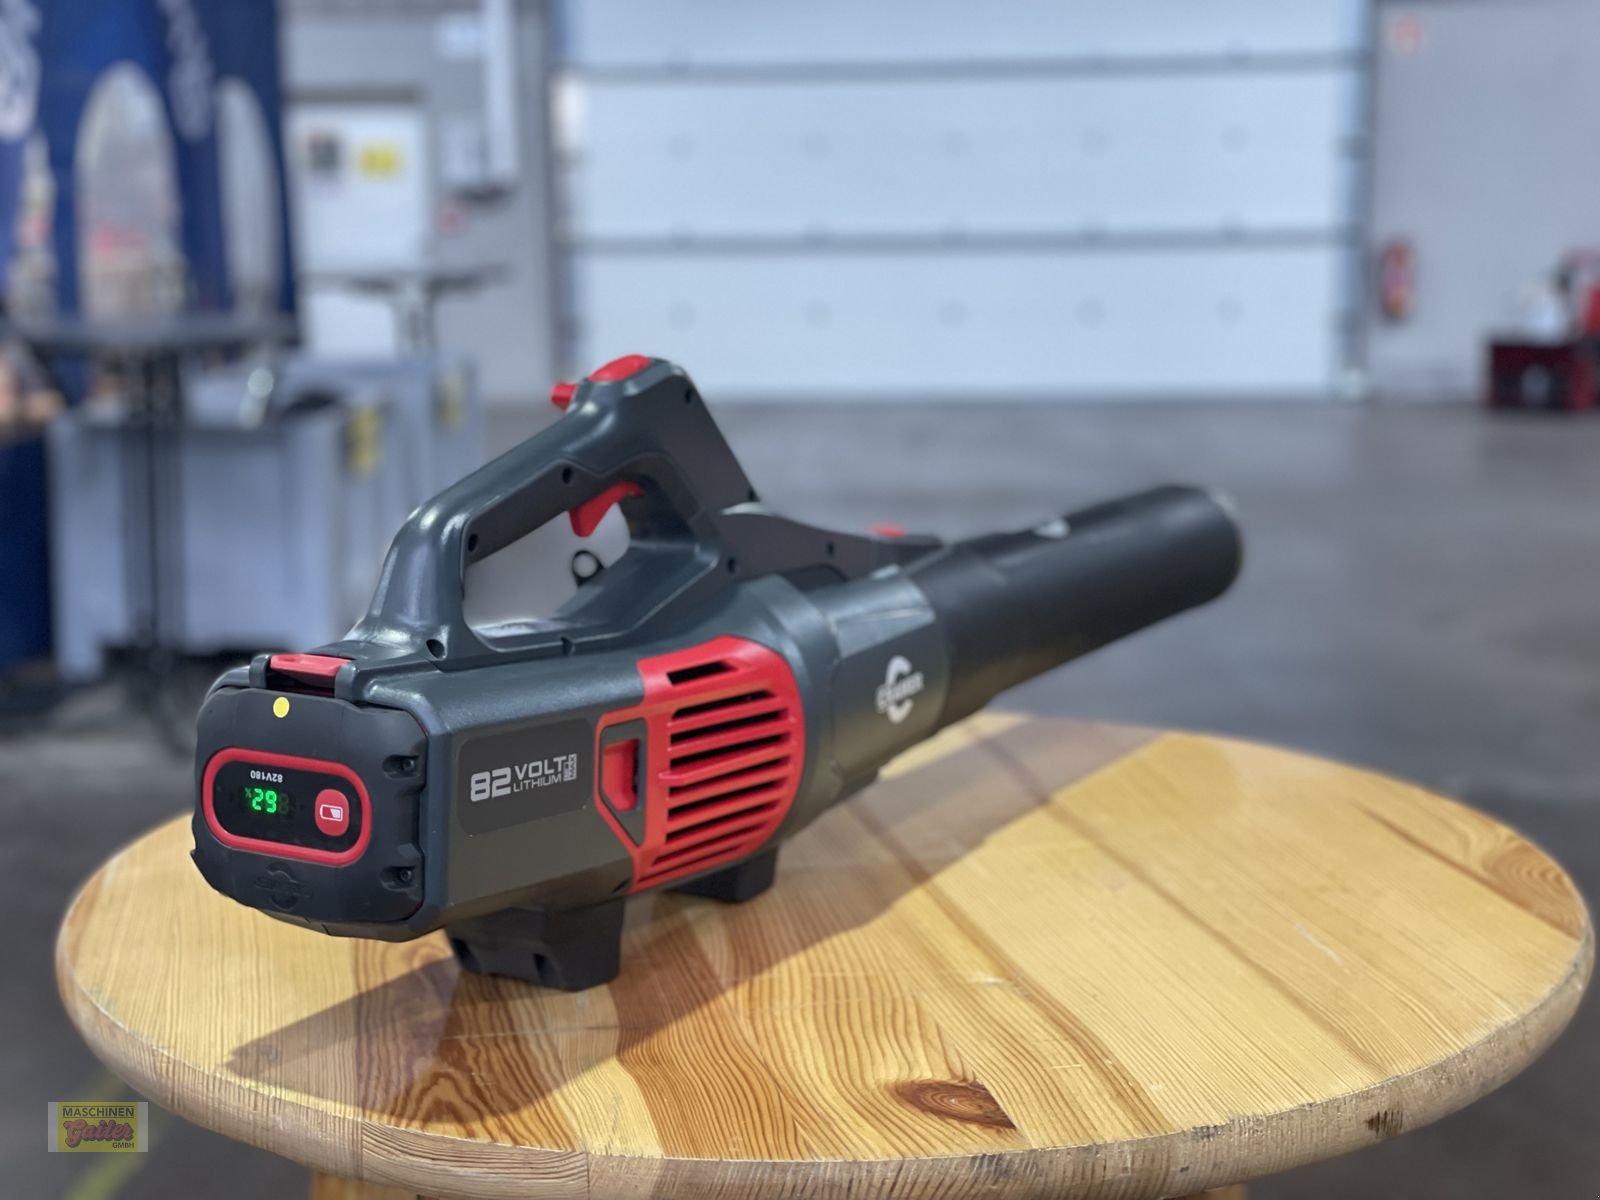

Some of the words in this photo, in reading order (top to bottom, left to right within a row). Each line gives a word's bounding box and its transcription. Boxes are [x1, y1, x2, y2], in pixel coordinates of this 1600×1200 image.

[250, 770, 283, 783] 82V180
[470, 767, 511, 802] 82
[514, 755, 567, 780] VOLT
[513, 773, 562, 792] LITHIUM
